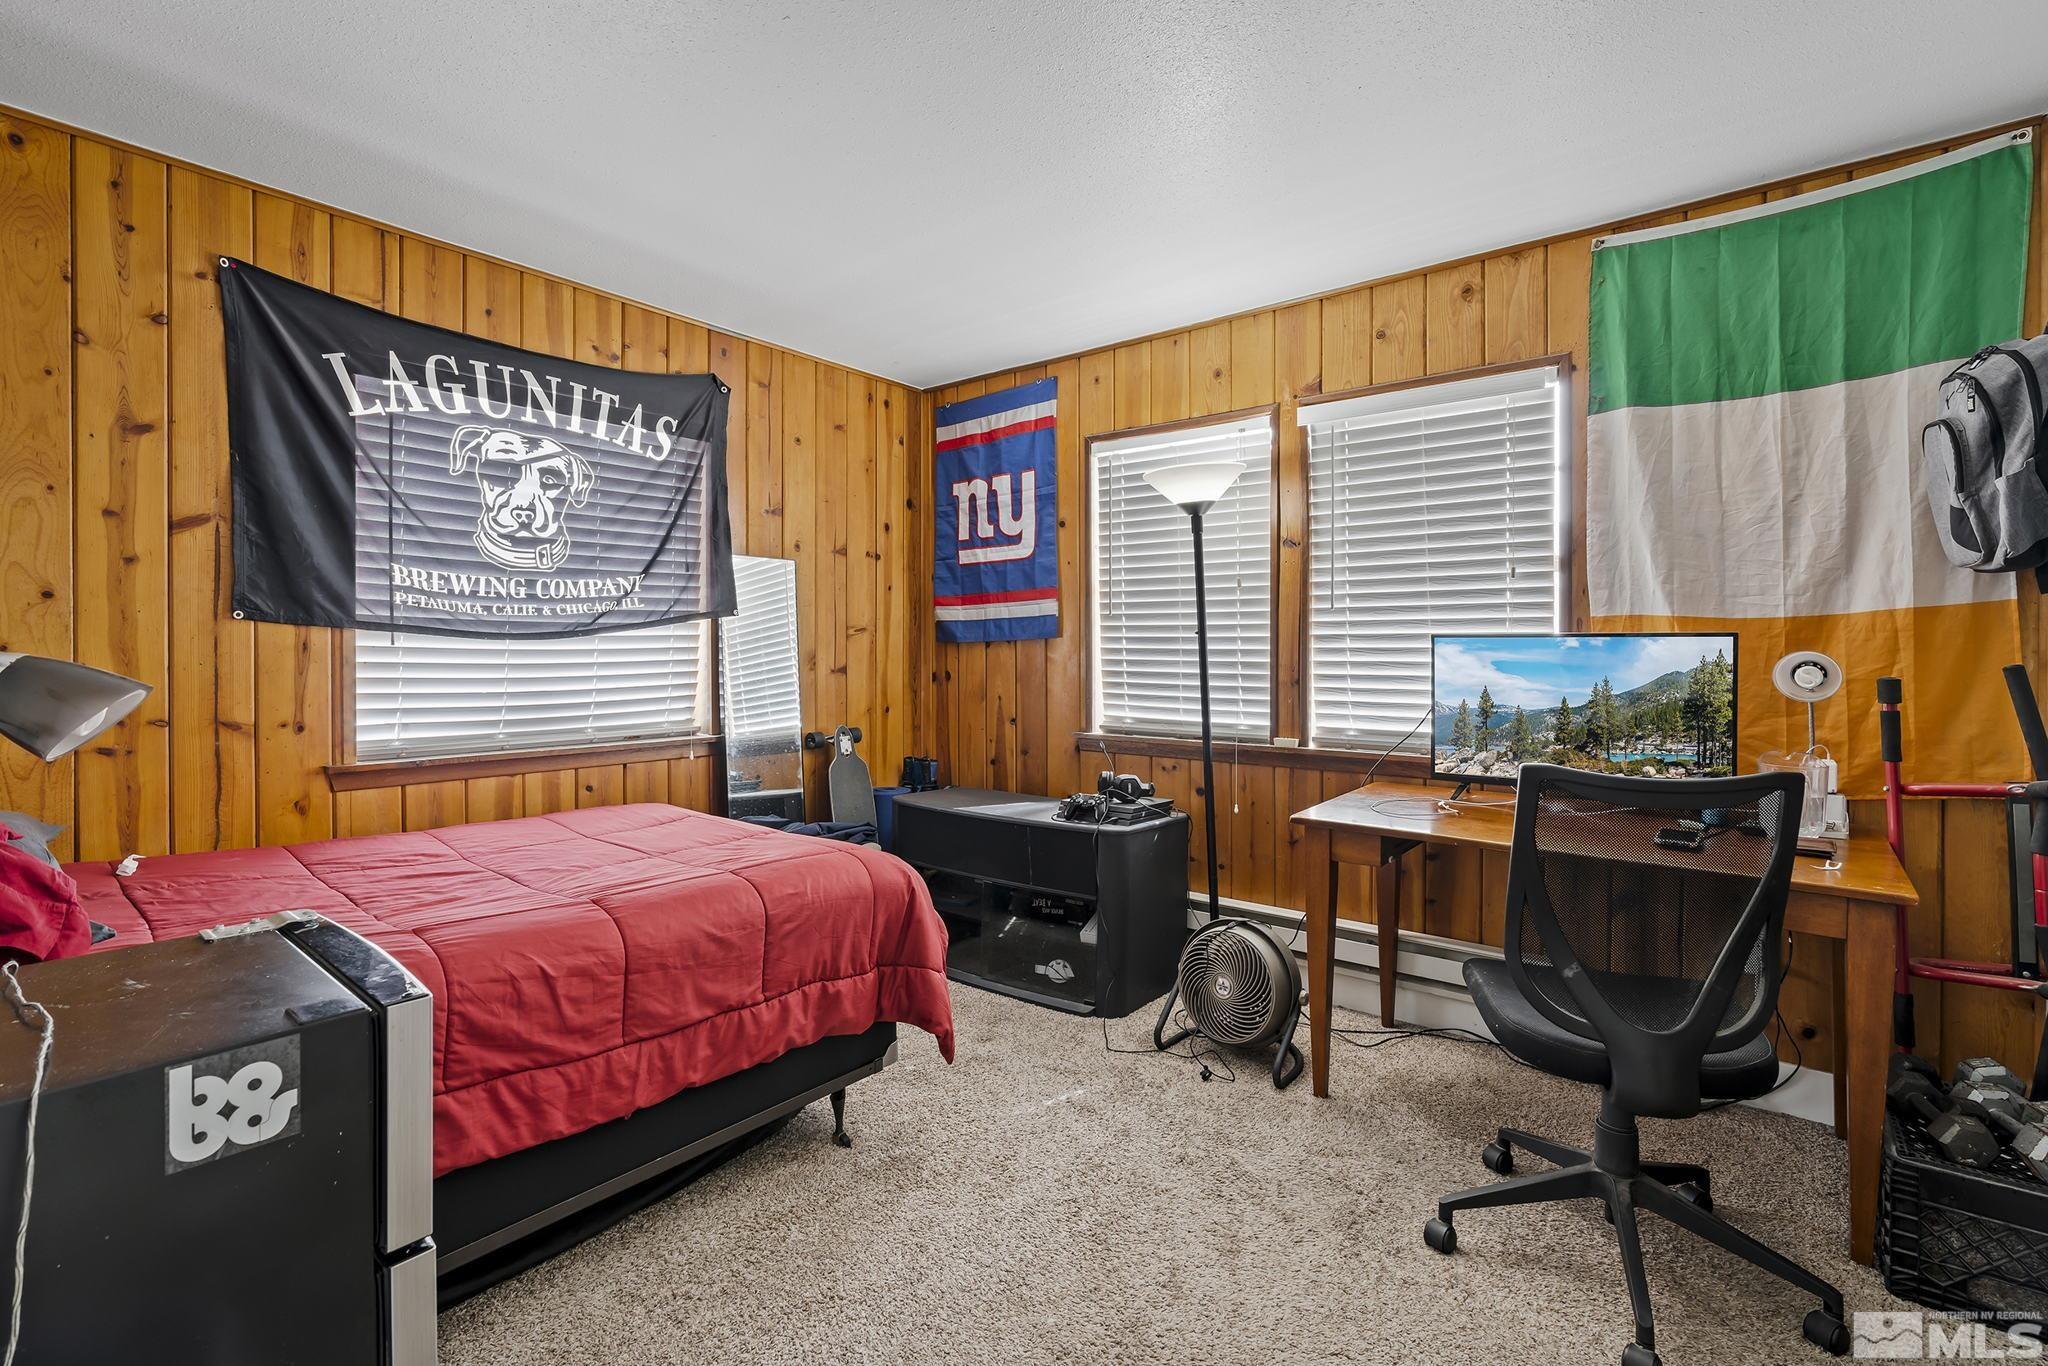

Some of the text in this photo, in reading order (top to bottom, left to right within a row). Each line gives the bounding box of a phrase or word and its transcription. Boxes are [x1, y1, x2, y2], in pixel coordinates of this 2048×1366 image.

[322, 350, 679, 461] LAGUNITAS
[391, 563, 646, 599] BREWING COMPANY
[542, 605, 552, 616] &
